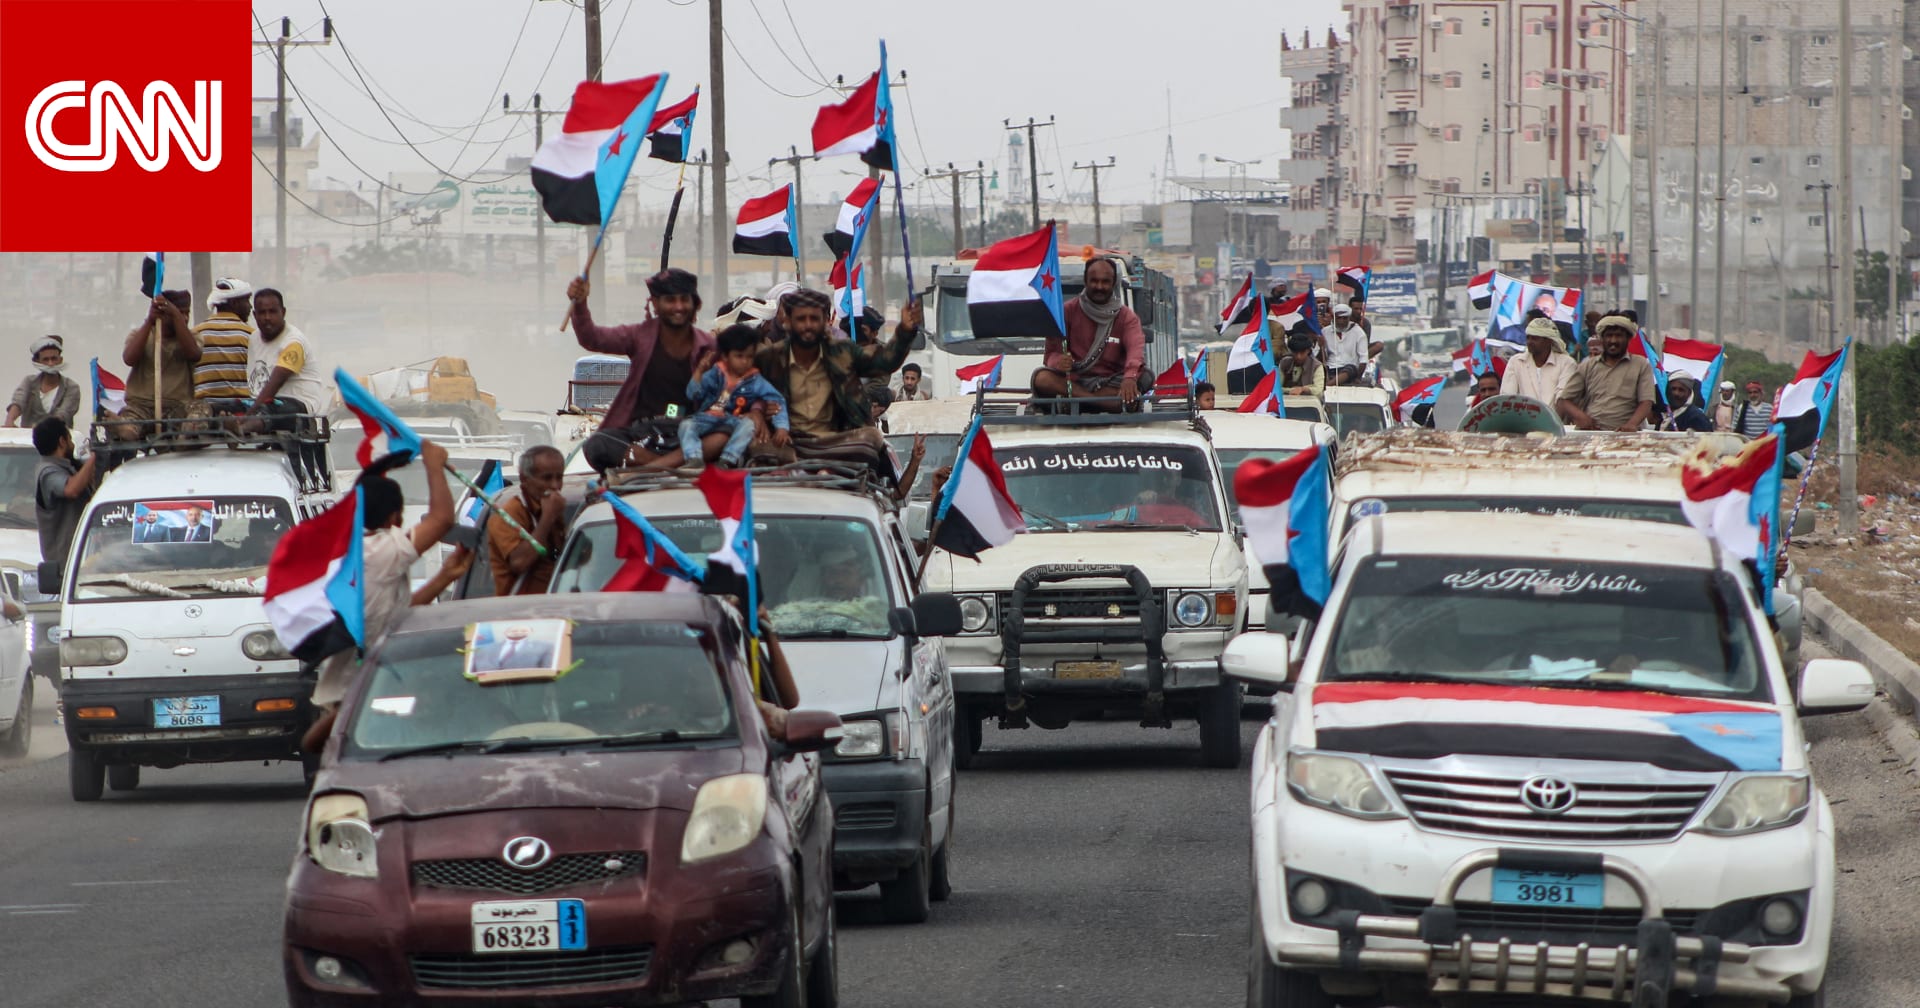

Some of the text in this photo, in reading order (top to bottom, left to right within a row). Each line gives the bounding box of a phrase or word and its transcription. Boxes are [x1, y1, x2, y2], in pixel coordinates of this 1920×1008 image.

[1002, 453, 1183, 472] ماشاء الله تبارك الله
[236, 501, 276, 520] ماشاء
[171, 715, 204, 726] 8098
[1517, 884, 1576, 903] 3981
[483, 925, 550, 948] 68323
